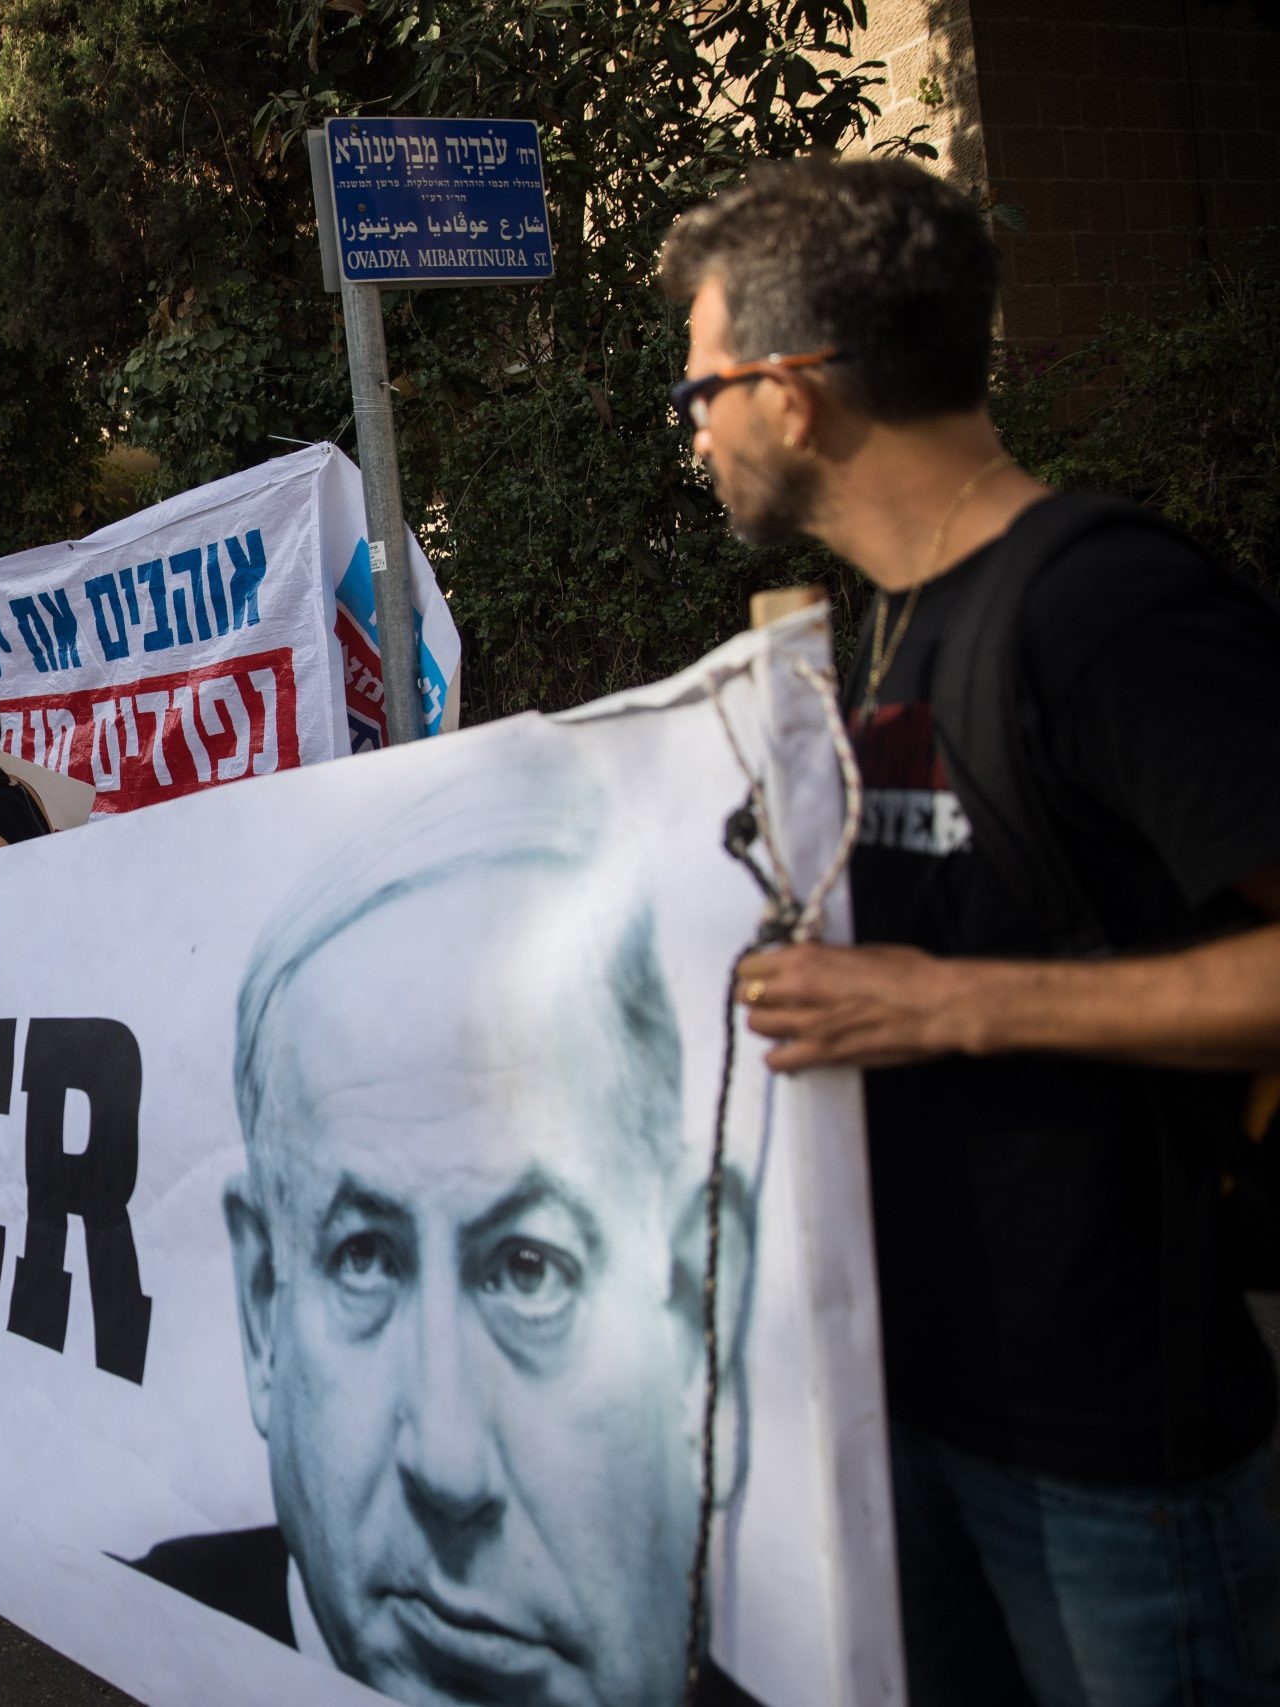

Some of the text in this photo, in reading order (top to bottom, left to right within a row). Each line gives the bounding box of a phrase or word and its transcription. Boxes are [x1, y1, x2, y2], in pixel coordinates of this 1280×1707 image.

[347, 249, 549, 270] OVADYA MIBARTINURA ST.
[500, 216, 545, 240] شارع
[9, 588, 83, 673] את
[84, 528, 268, 662] אוהבים
[90, 667, 279, 791] נפרדים
